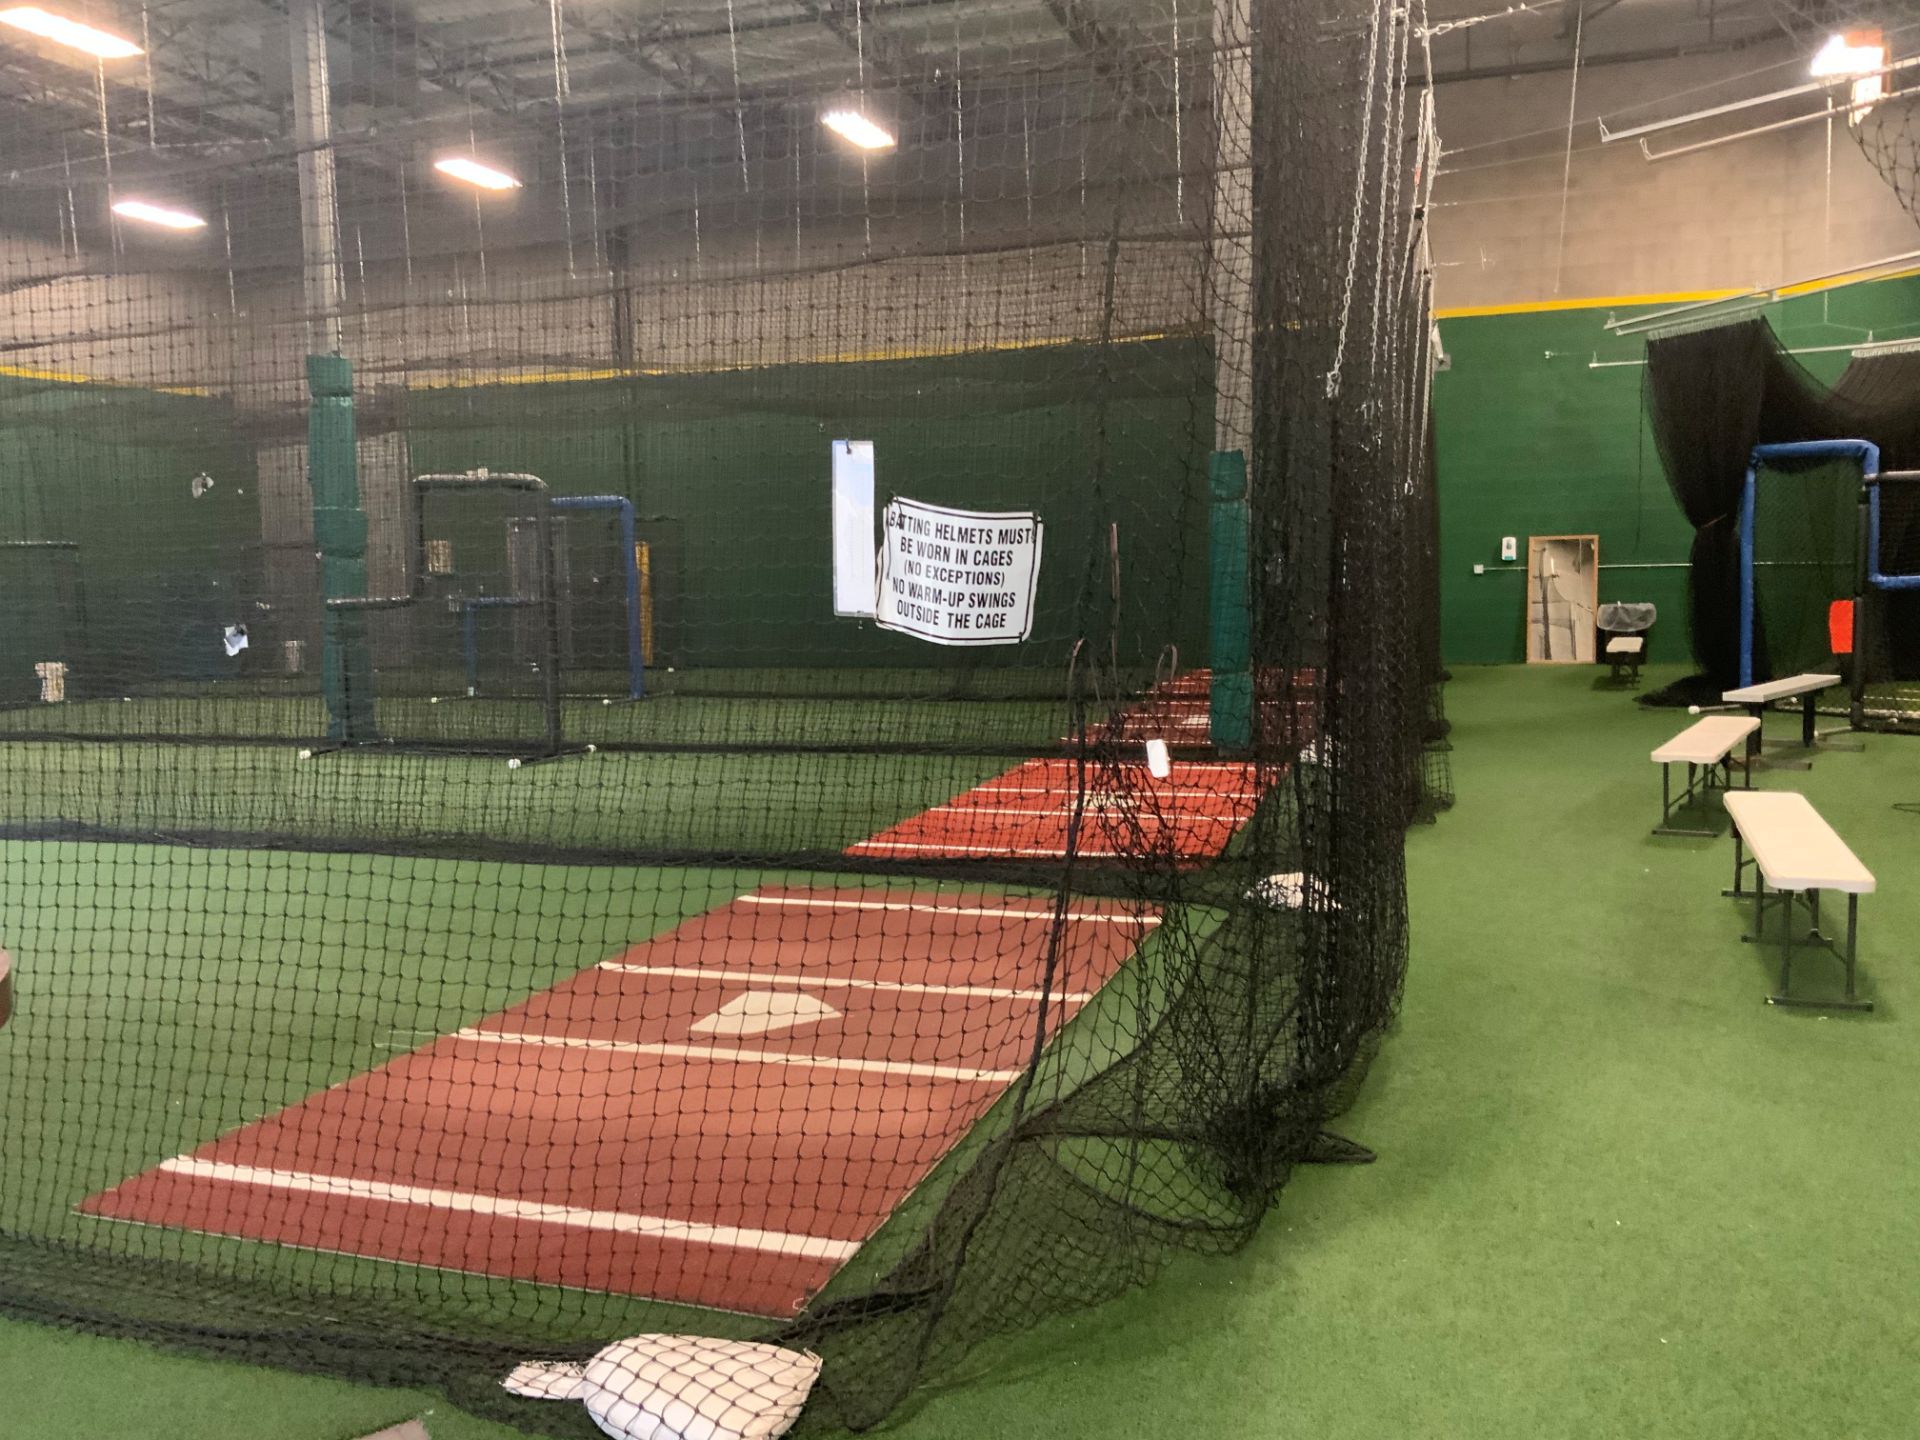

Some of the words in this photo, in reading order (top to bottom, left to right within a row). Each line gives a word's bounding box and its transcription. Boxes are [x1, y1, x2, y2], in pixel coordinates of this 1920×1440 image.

[935, 523, 992, 544] HELMETS
[998, 529, 1031, 544] MUST
[901, 537, 912, 554] BE
[917, 541, 950, 563] WORN
[956, 549, 967, 566] IN
[974, 550, 1013, 567] CAGES
[904, 559, 921, 576] (NO
[926, 567, 1005, 588] EXCEPTIONS)
[893, 577, 904, 595] NO
[908, 584, 964, 607] WARM-UP
[968, 592, 1016, 608] SWINGS
[897, 600, 939, 626] OUTSIDE
[948, 613, 970, 628] THE
[976, 614, 1006, 628] CAGE
